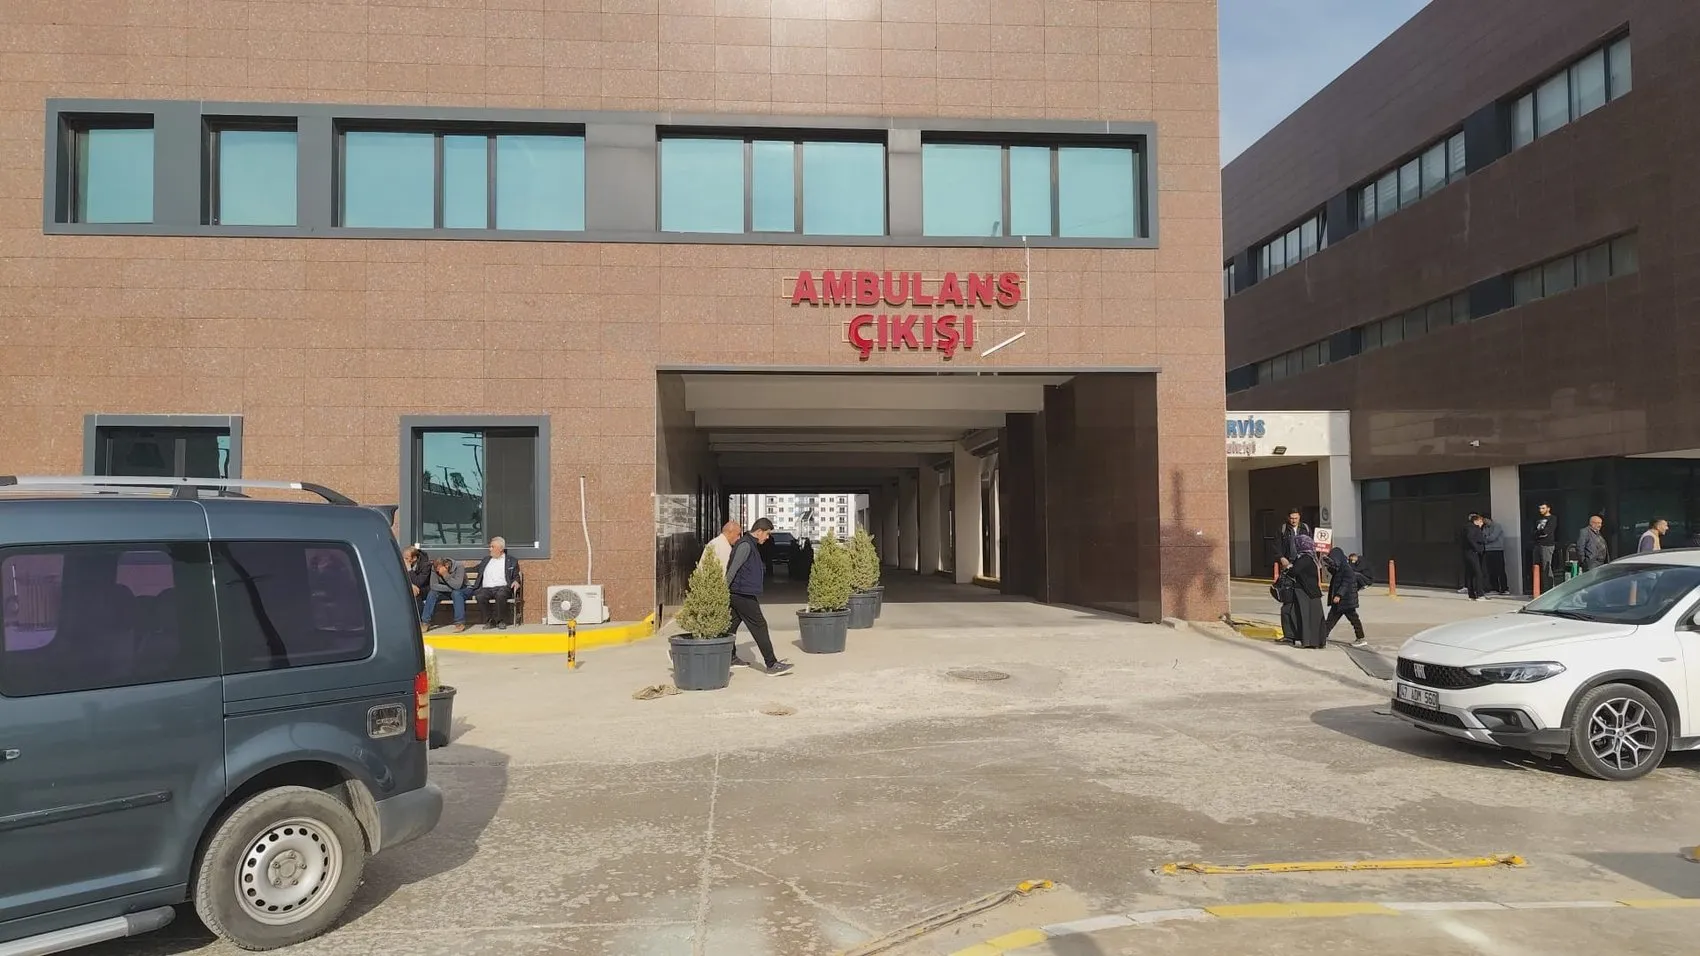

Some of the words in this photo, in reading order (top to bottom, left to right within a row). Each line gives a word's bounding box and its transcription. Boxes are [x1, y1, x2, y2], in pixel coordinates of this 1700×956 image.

[791, 270, 1022, 307] AMBULANS
[848, 314, 974, 361] ÇIKIŞI
[1226, 415, 1265, 438] RVİS
